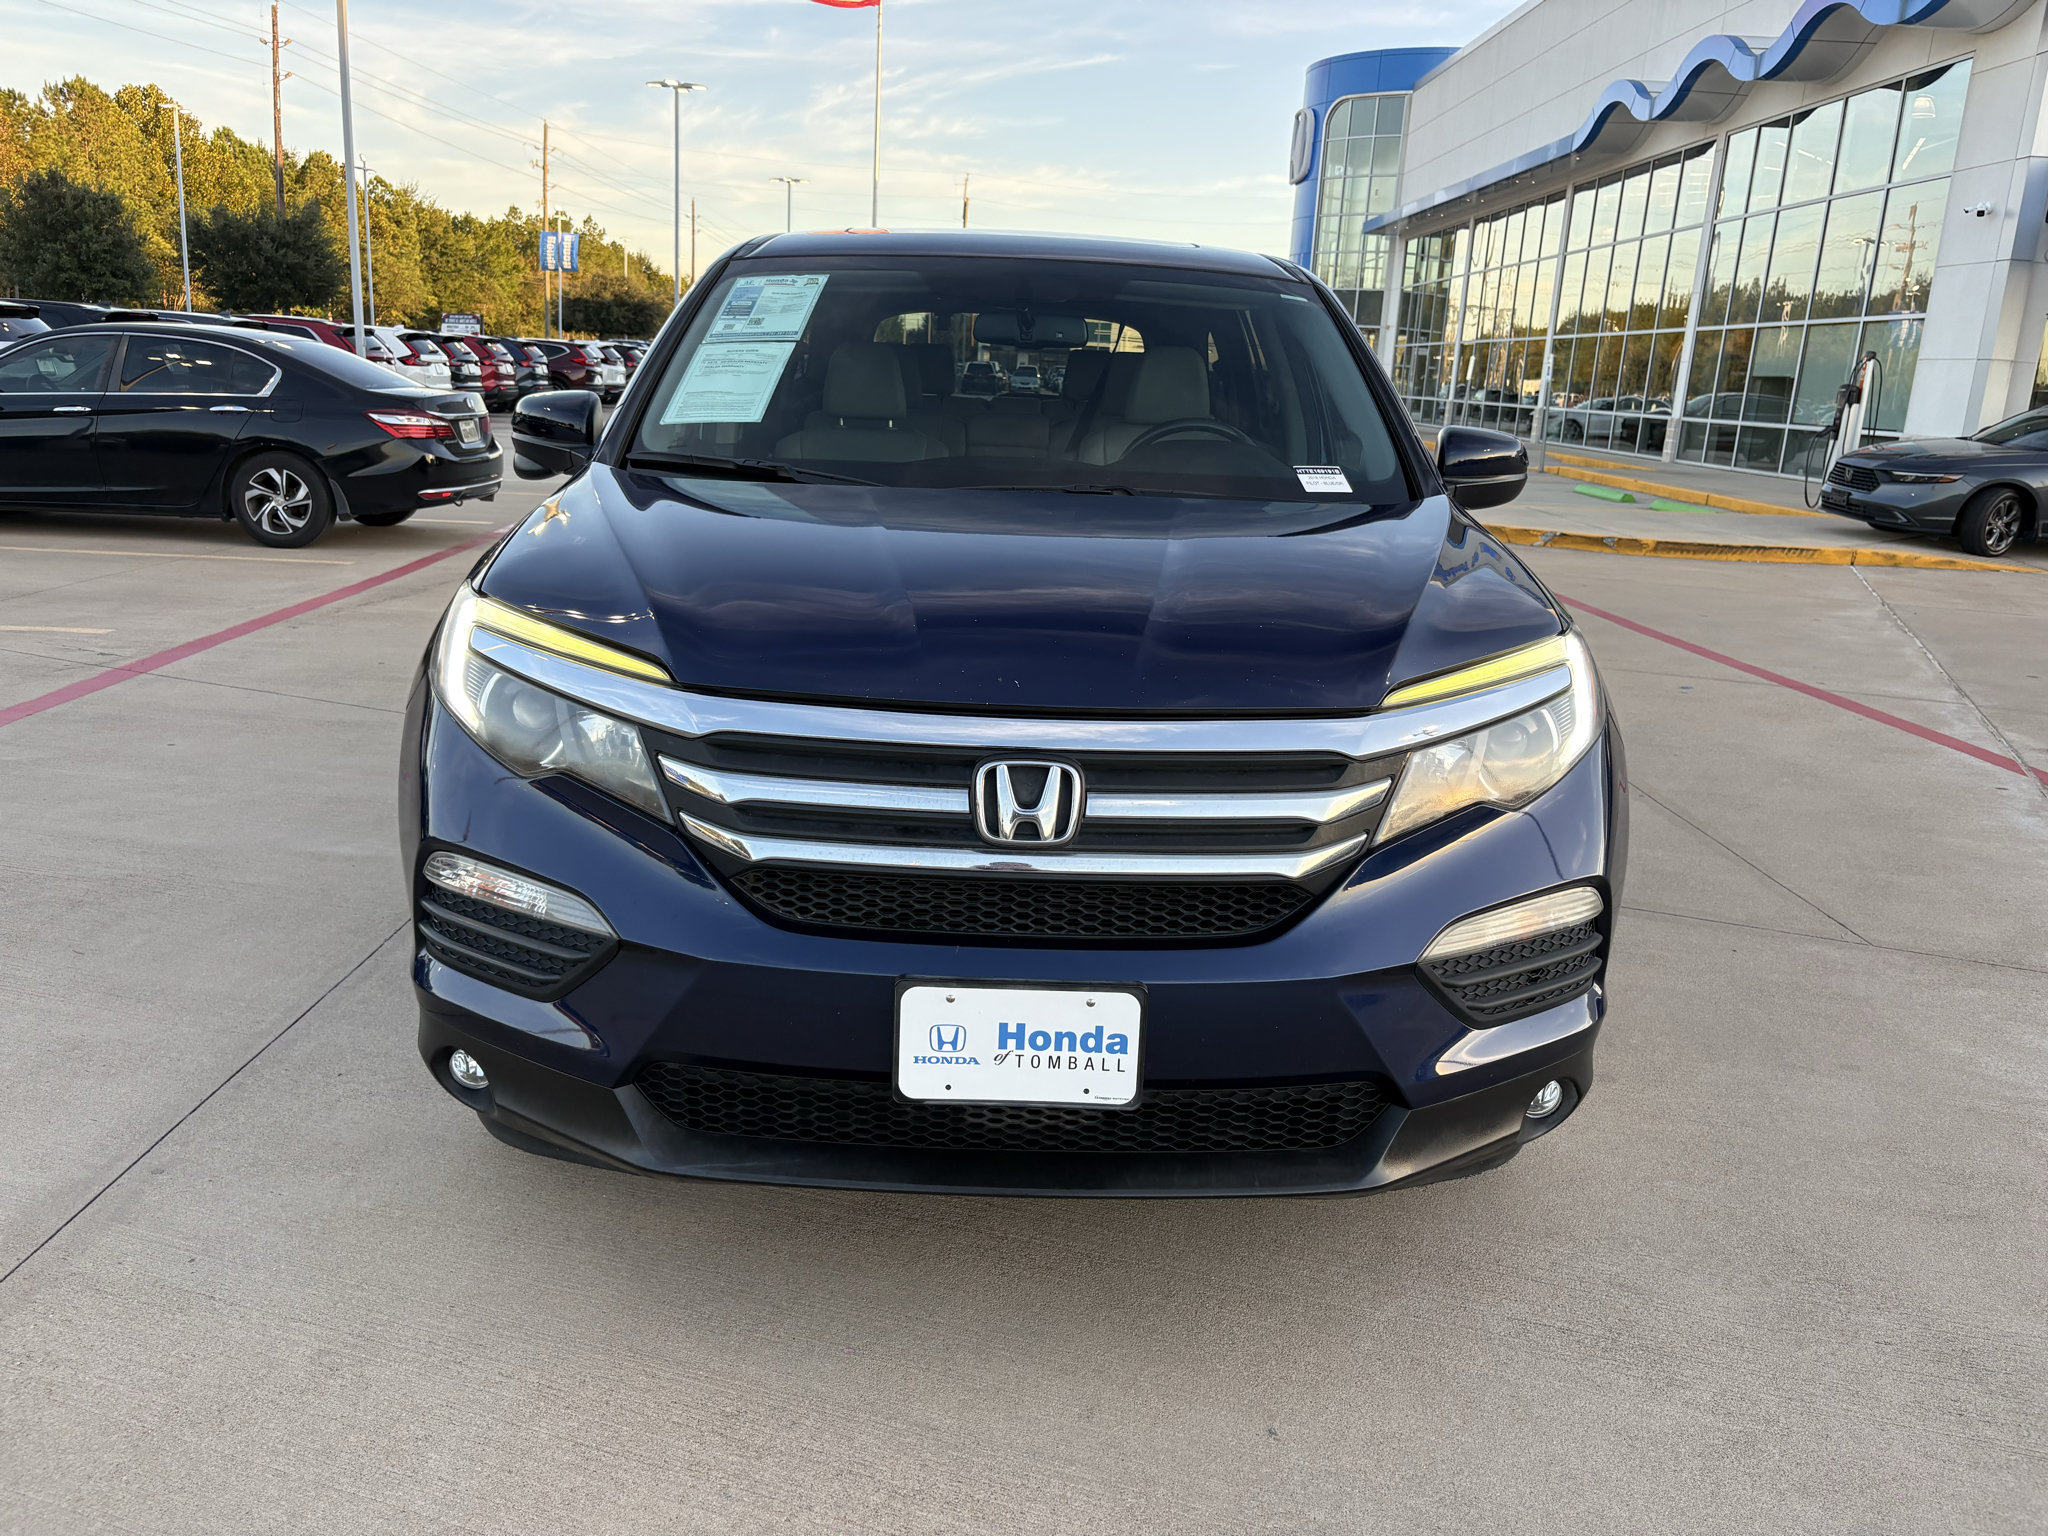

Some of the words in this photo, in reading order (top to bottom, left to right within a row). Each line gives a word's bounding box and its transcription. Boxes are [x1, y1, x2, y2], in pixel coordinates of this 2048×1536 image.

[997, 1022, 1129, 1055] Honda
[913, 1055, 981, 1065] HONDA
[993, 1049, 1014, 1066] of
[1015, 1054, 1126, 1073] TOMBALL
